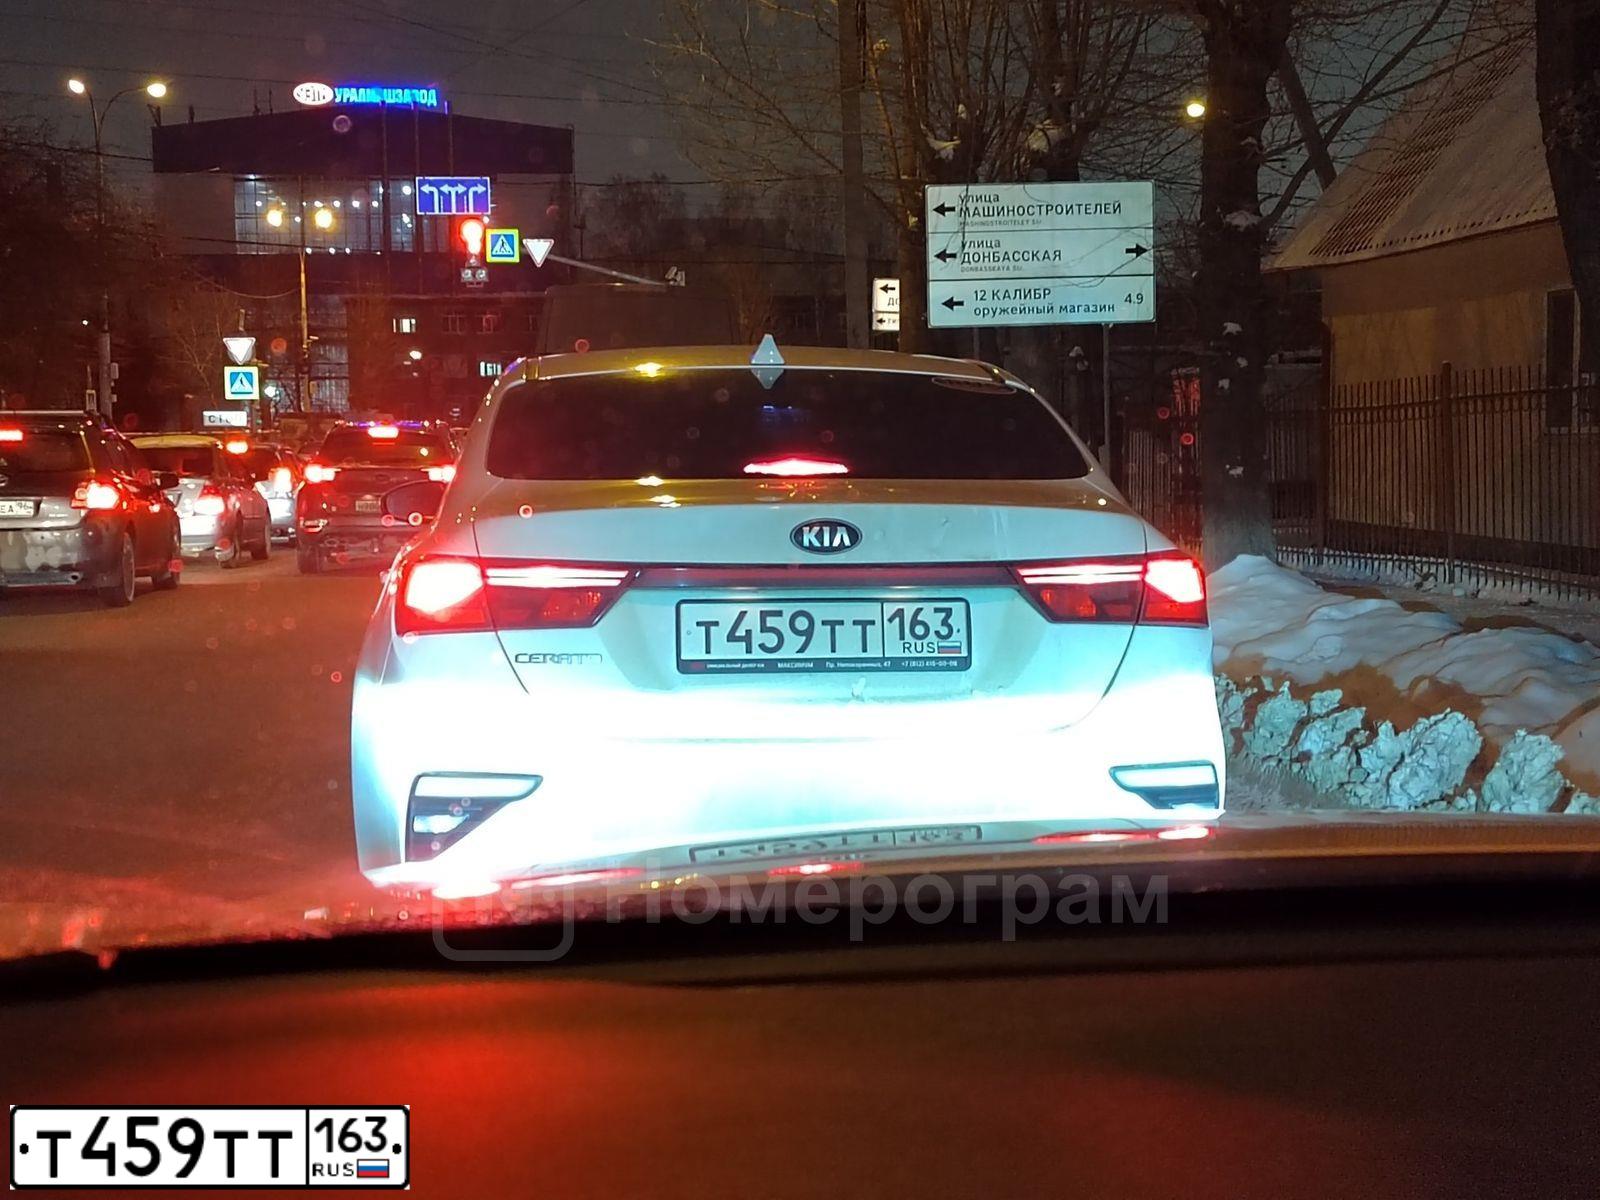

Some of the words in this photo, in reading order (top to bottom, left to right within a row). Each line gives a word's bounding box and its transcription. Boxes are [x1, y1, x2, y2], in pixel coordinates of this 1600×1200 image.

[959, 193, 1000, 205] улица
[960, 201, 1121, 217] МАШИНОСТРОИТЕЛЕЙ
[961, 239, 1001, 251] улица
[961, 250, 1062, 265] ДОНБАССКАЯ
[974, 289, 987, 301] 12
[992, 288, 1052, 300] КАЛИБР
[1124, 293, 1144, 305] 4.9
[973, 304, 1054, 317] оружейный
[1059, 303, 1116, 315] магазин
[802, 526, 851, 547] KIA
[696, 609, 876, 655] Т459ТТ
[887, 606, 955, 641] 163
[903, 641, 936, 654] RUS
